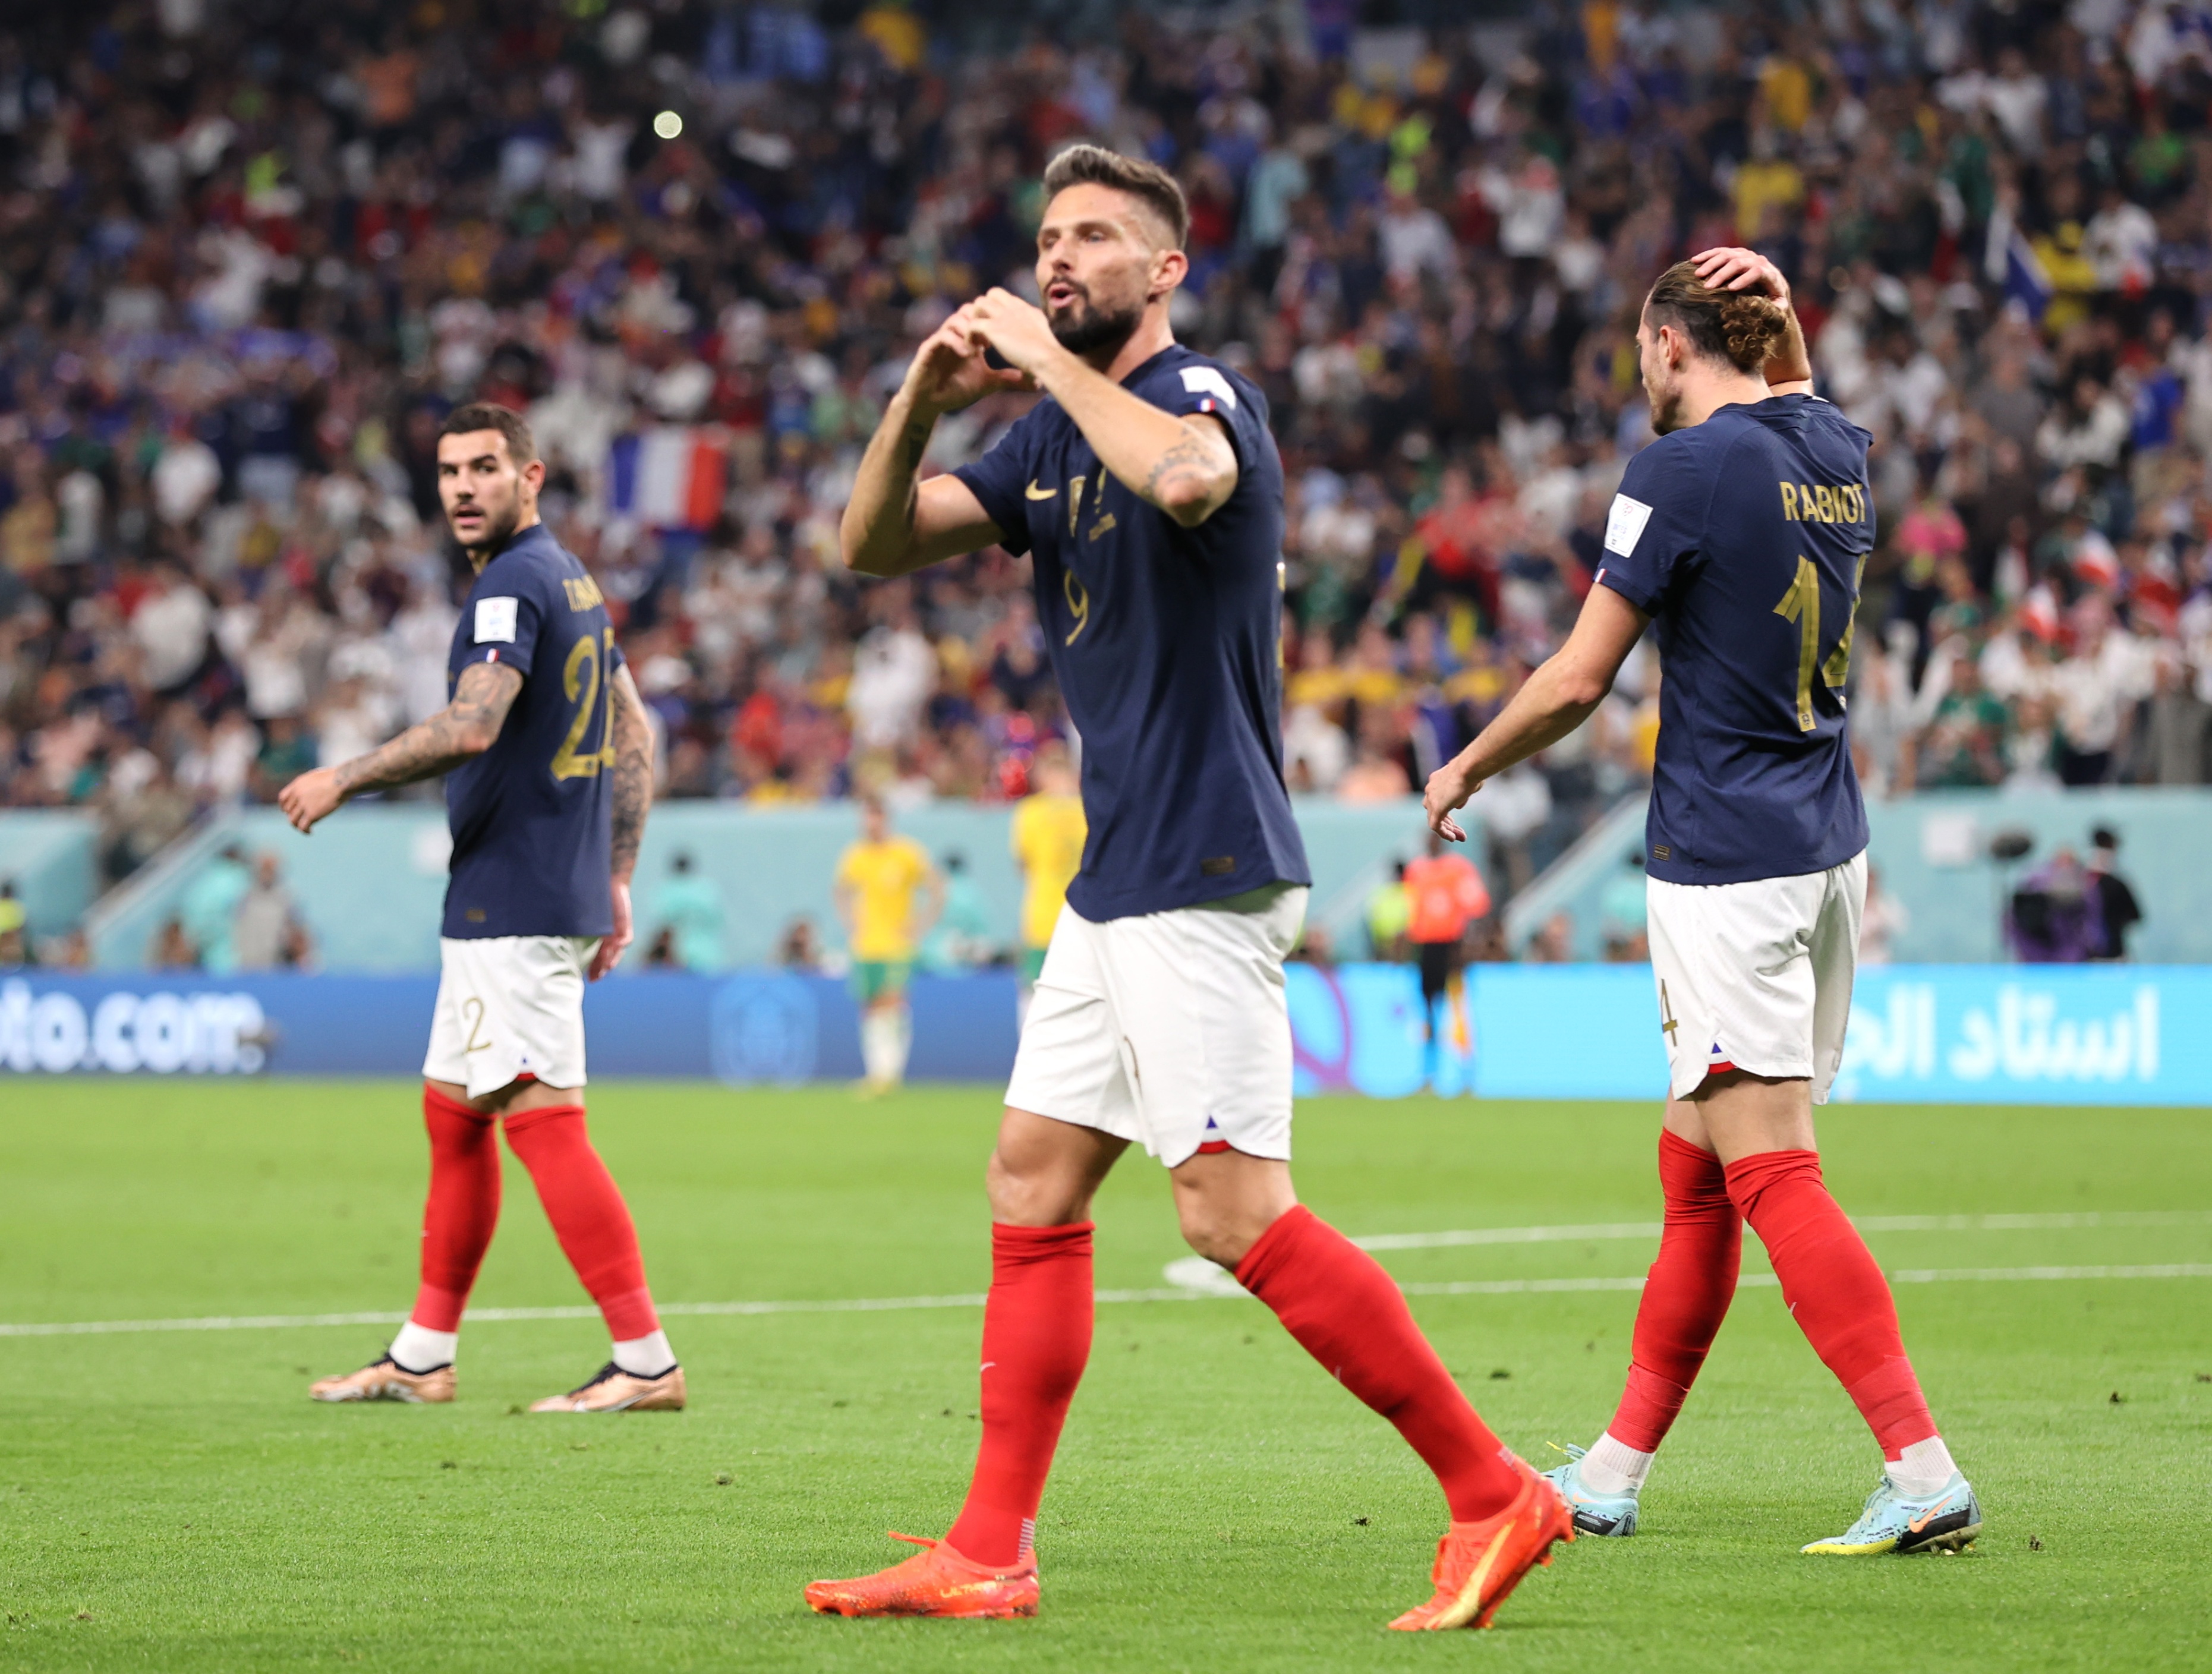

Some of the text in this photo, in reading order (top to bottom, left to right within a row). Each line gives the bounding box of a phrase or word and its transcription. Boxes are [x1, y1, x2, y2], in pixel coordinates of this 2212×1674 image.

[1779, 481, 1865, 524] RABIOT
[1064, 569, 1088, 646] 9
[462, 998, 491, 1055] 2
[1948, 981, 2160, 1083] استاد
